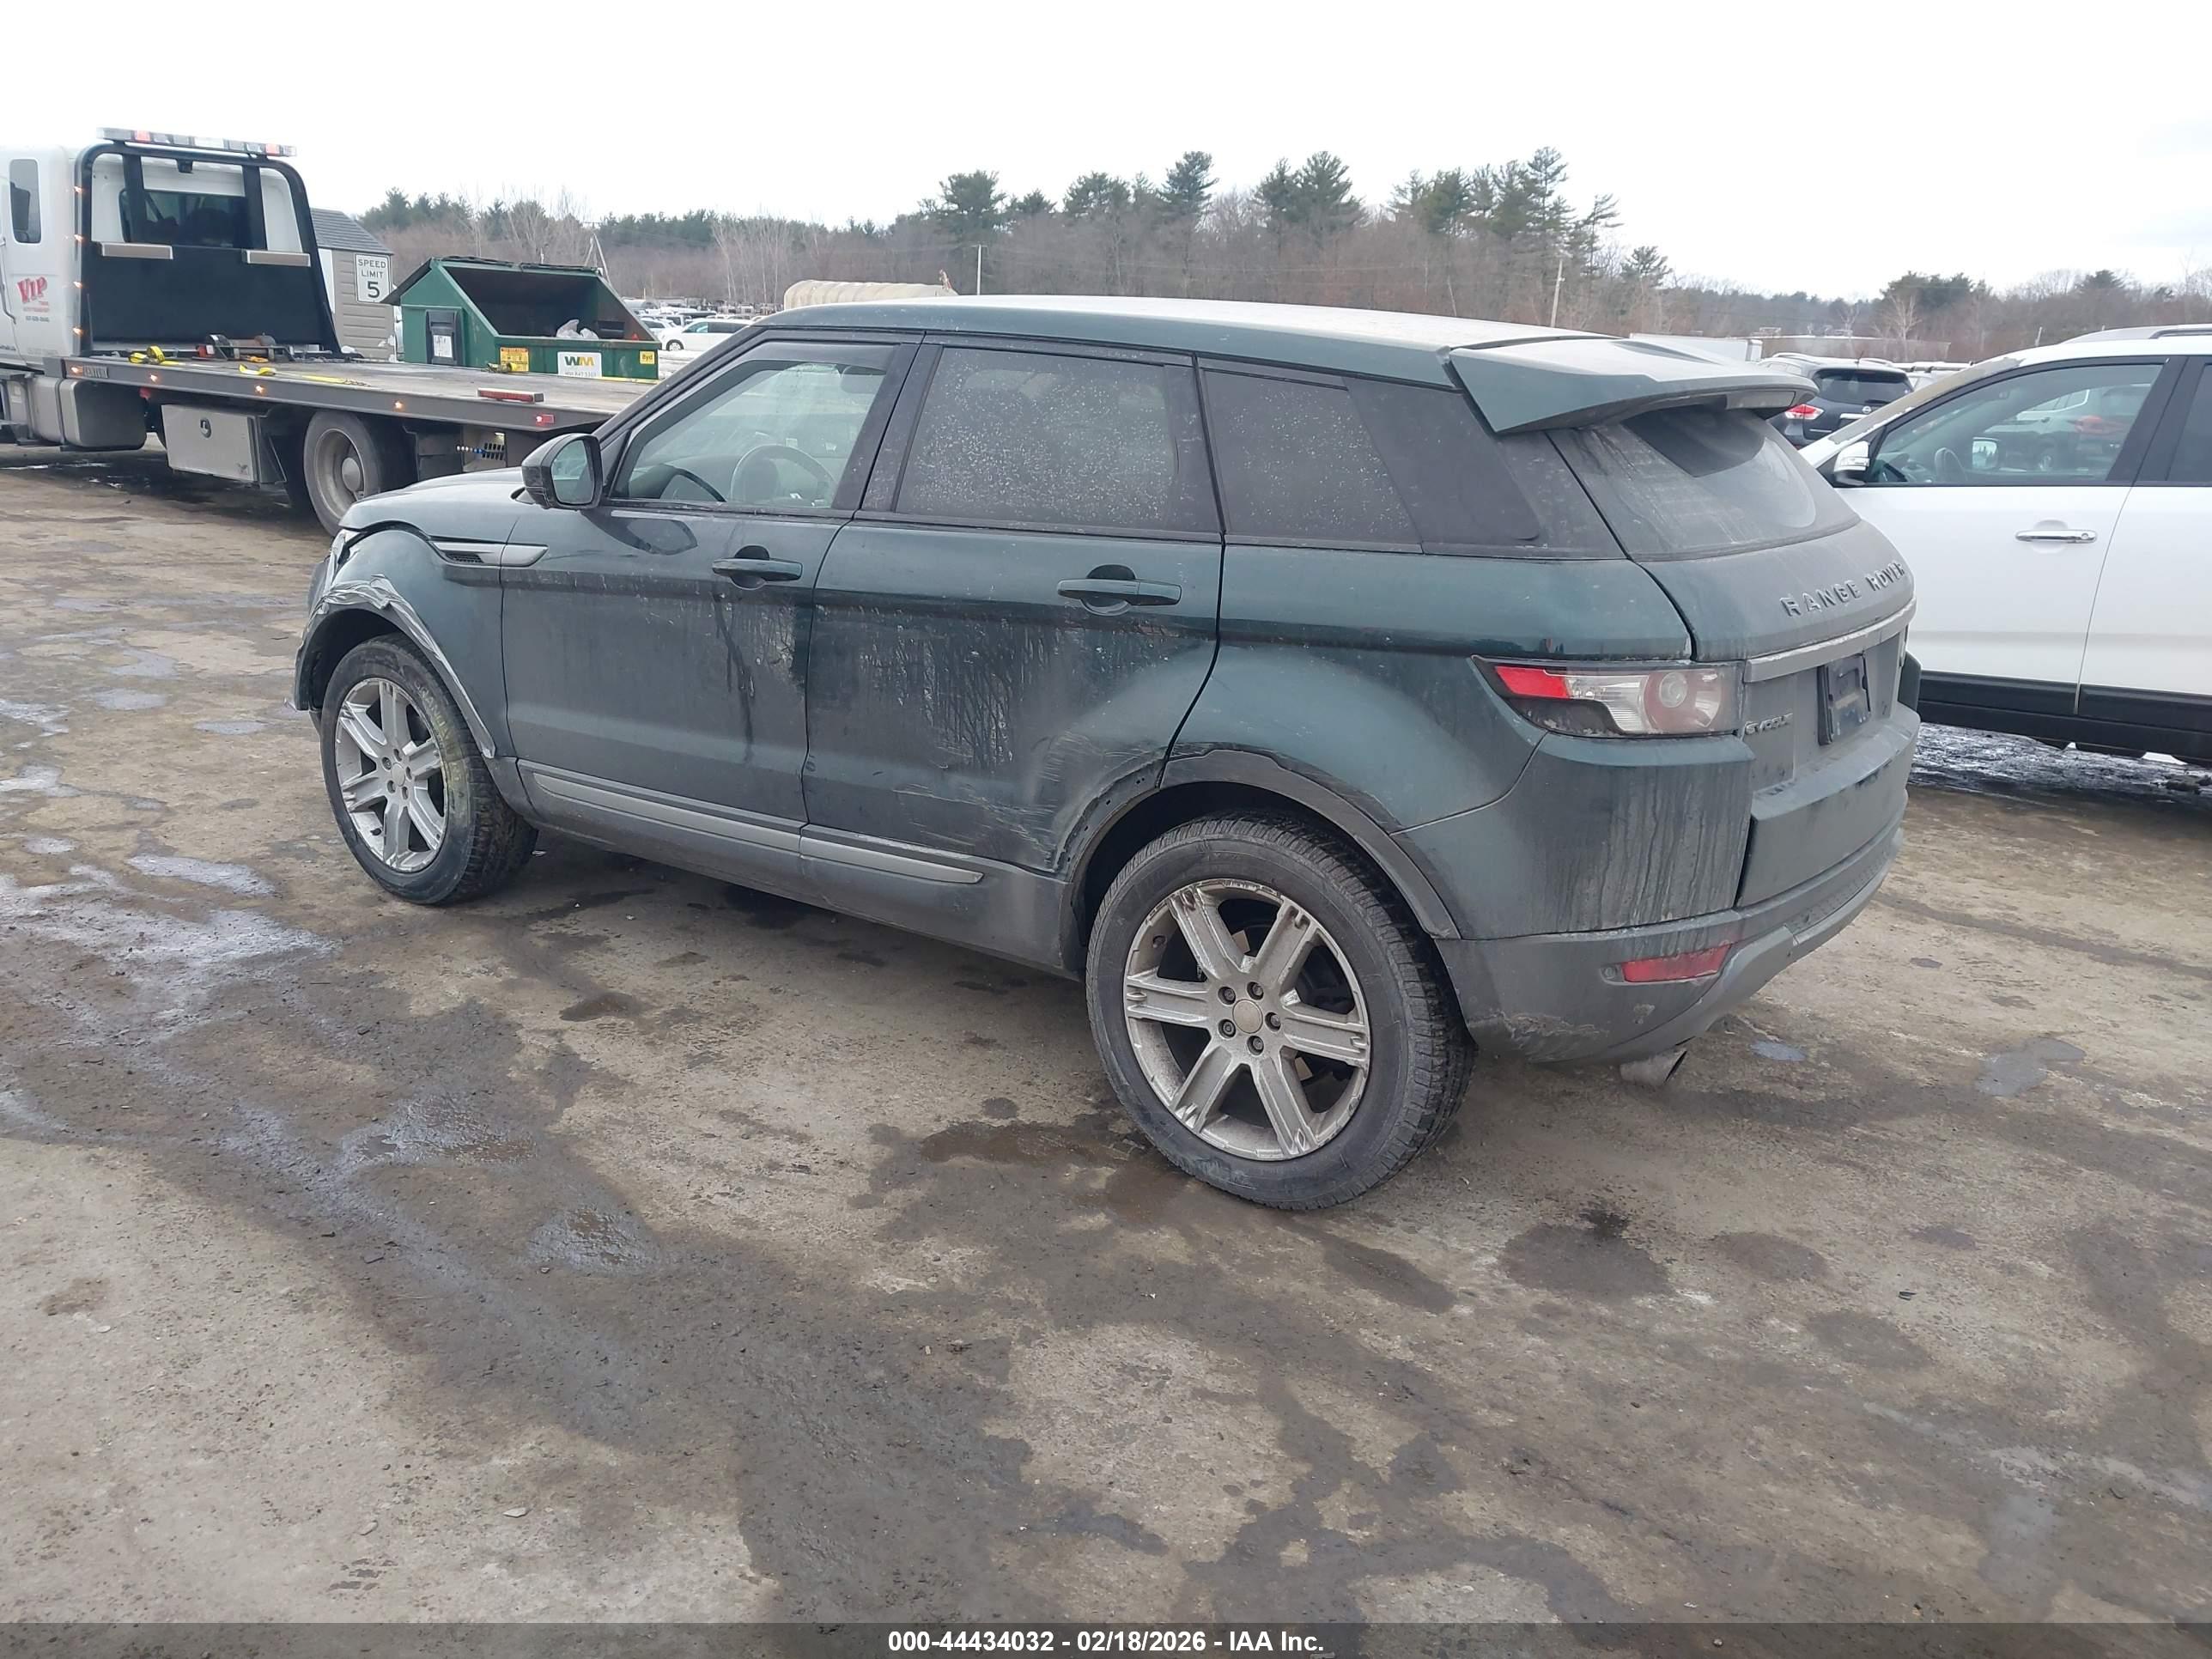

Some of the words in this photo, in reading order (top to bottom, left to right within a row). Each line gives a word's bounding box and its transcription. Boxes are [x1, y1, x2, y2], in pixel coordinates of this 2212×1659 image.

[358, 259, 386, 268] SPEED
[362, 270, 384, 278] LIMIT
[17, 276, 48, 303] VIP
[368, 281, 380, 298] 5
[564, 356, 595, 366] WM
[1779, 580, 1863, 617] RANGE
[1864, 559, 1905, 592] ROVER
